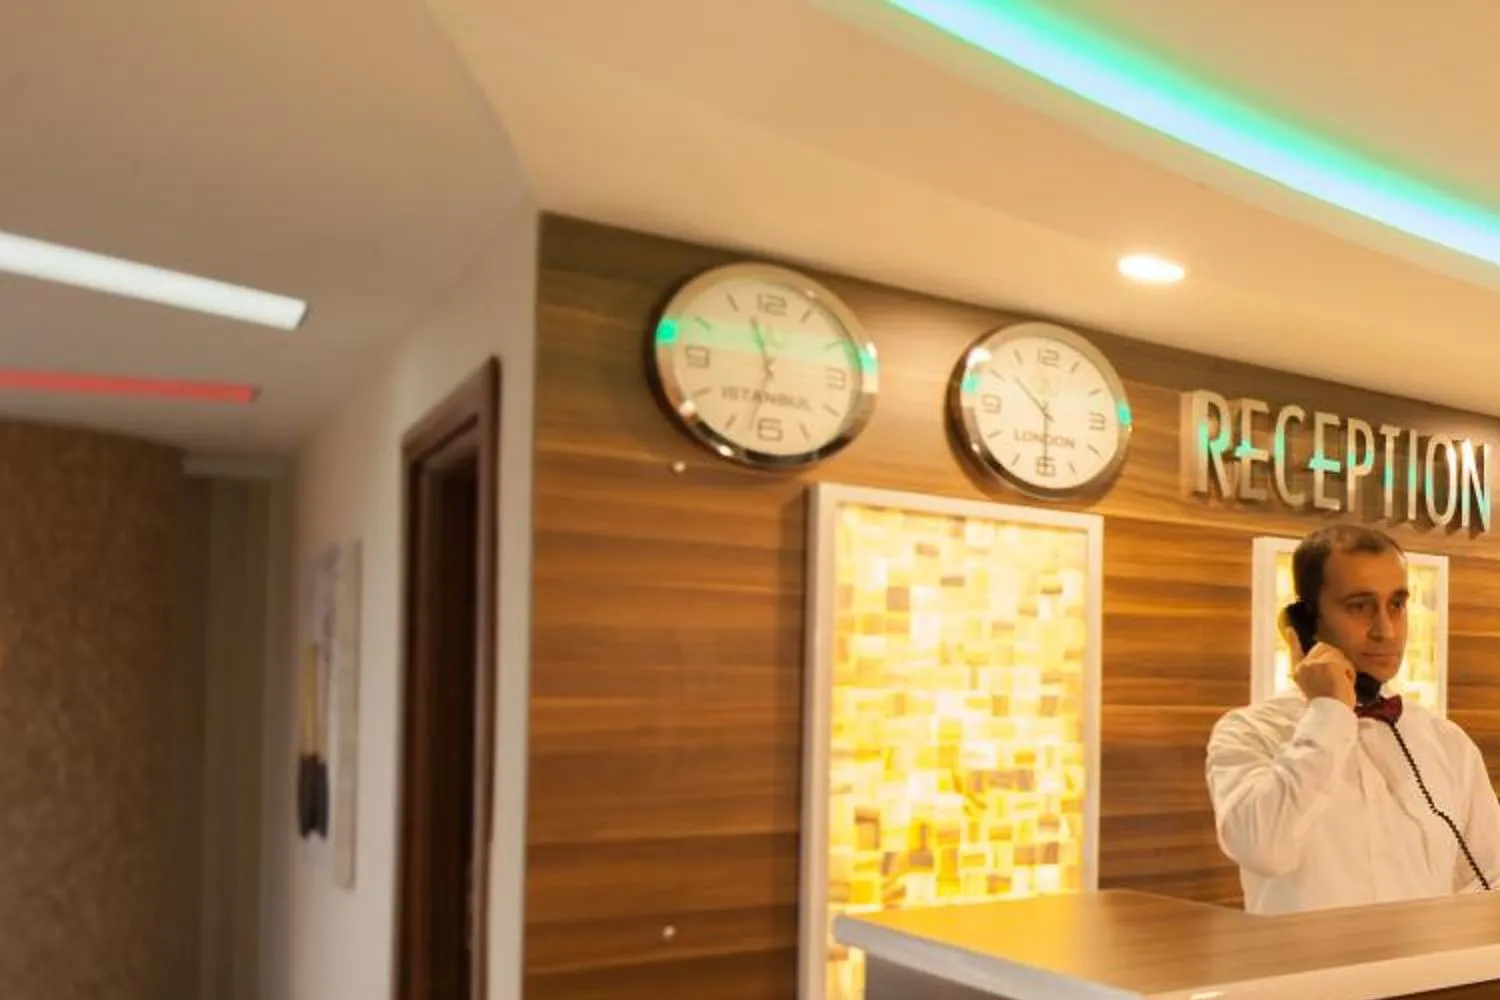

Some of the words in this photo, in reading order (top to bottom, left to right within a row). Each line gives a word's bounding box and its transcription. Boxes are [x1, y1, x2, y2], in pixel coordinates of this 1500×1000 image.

[685, 345, 711, 369] 9
[826, 367, 848, 390] 3
[982, 393, 1002, 414] 9
[756, 417, 784, 442] 6
[1014, 428, 1076, 448] LONDON
[1186, 388, 1491, 533] RECEPTION
